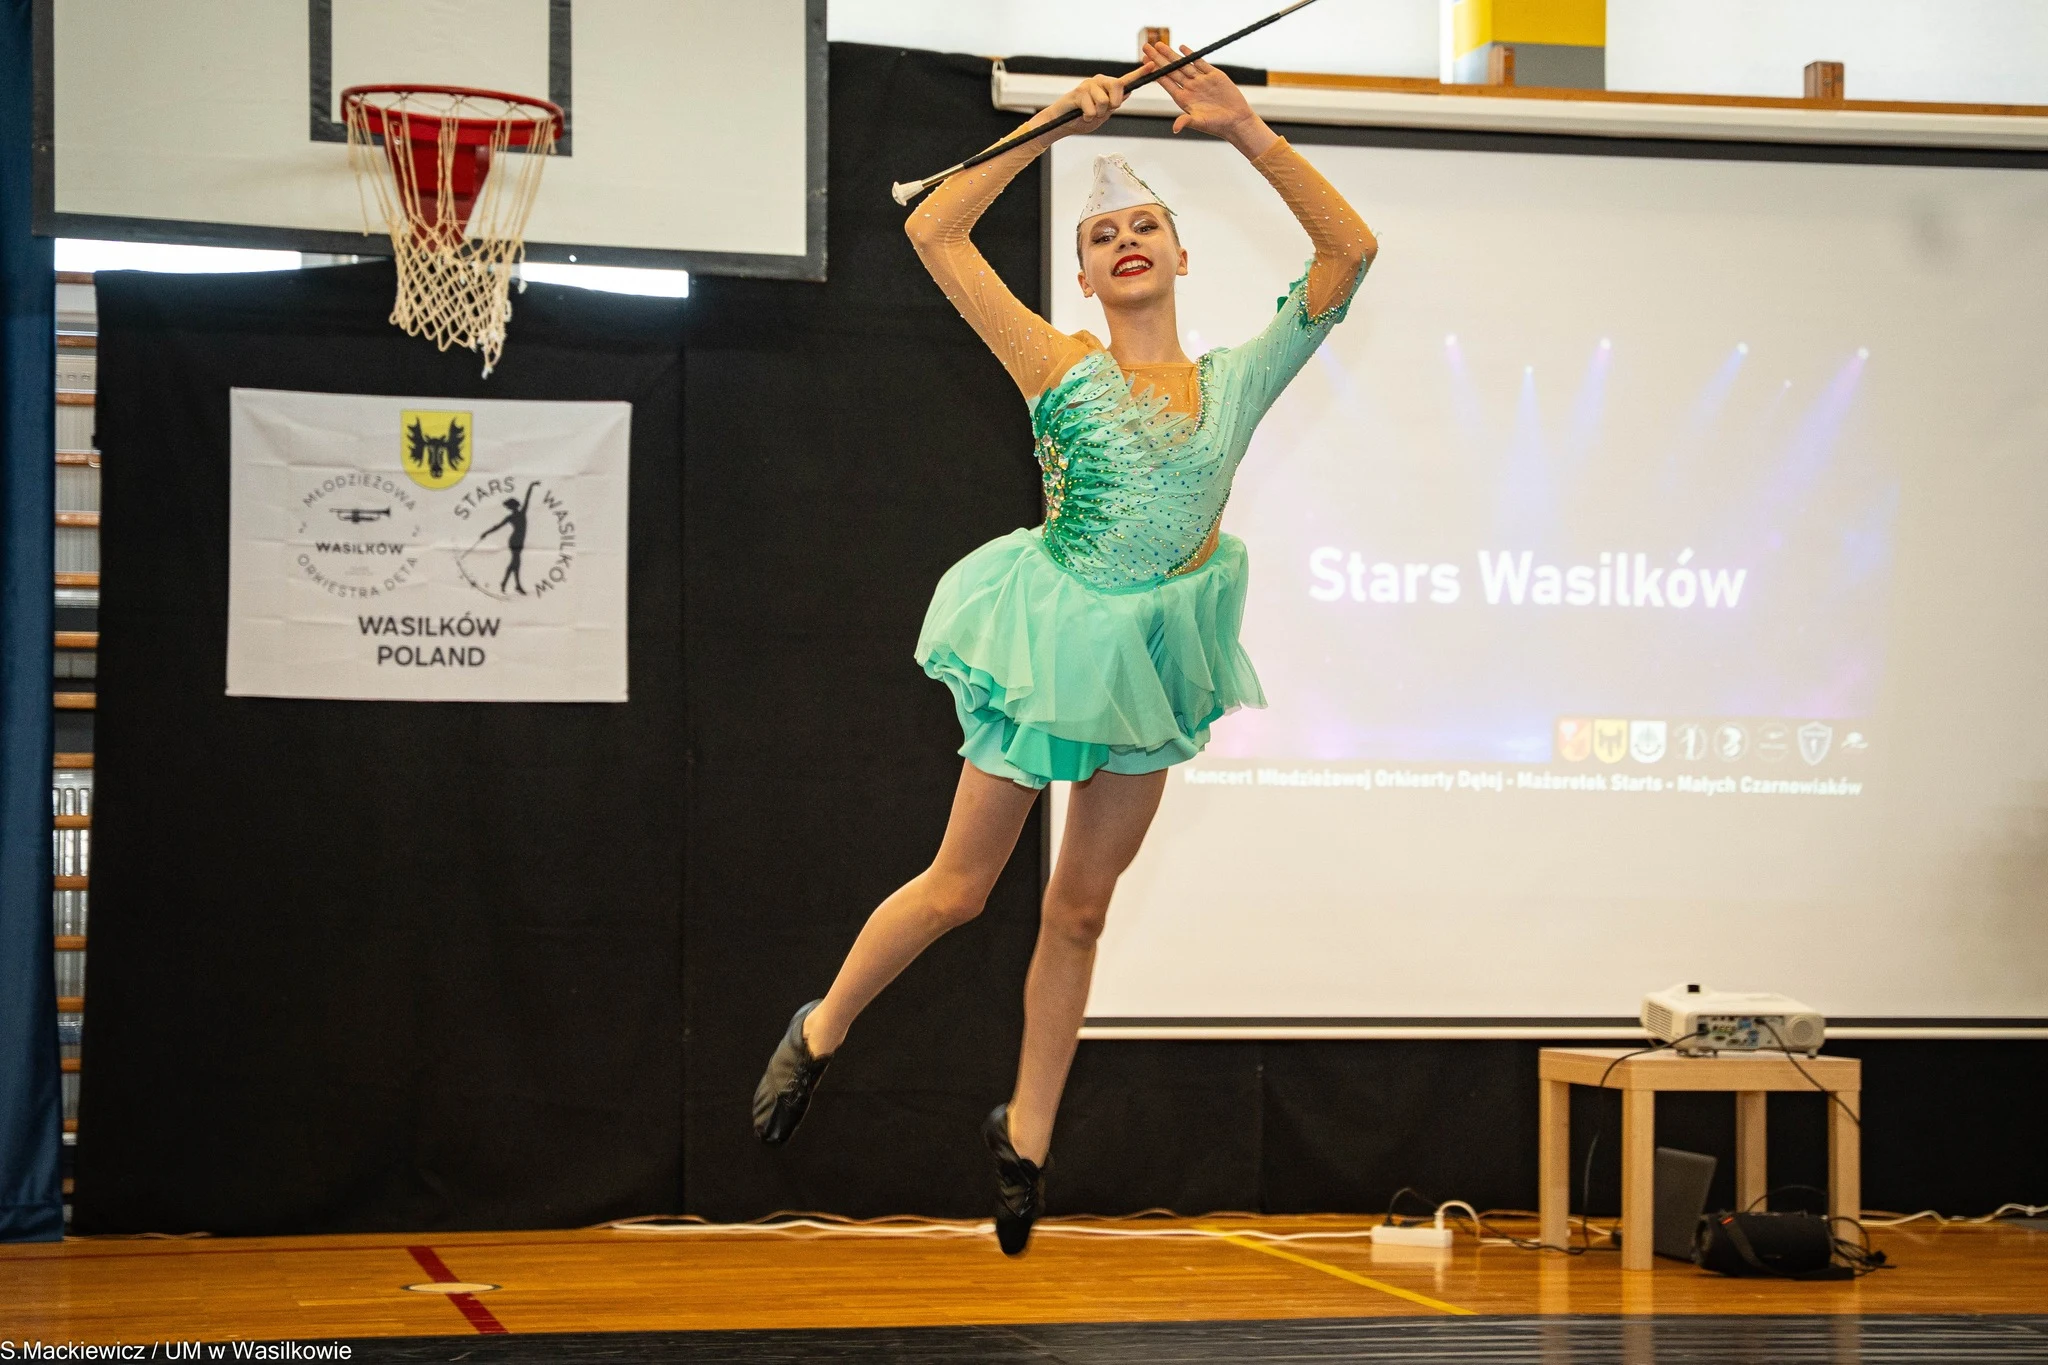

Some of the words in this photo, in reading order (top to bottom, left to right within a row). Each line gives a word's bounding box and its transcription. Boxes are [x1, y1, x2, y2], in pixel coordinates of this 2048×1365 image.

[453, 476, 515, 520] STARS
[534, 489, 576, 599] WASILKÓW
[297, 553, 380, 599] ORKIESTRA
[1308, 546, 1461, 604] Stars
[1477, 547, 1748, 608] Wasilków
[358, 610, 501, 637] WASILKÓW
[377, 645, 486, 667] POLAND
[1184, 768, 1253, 785] Koncert
